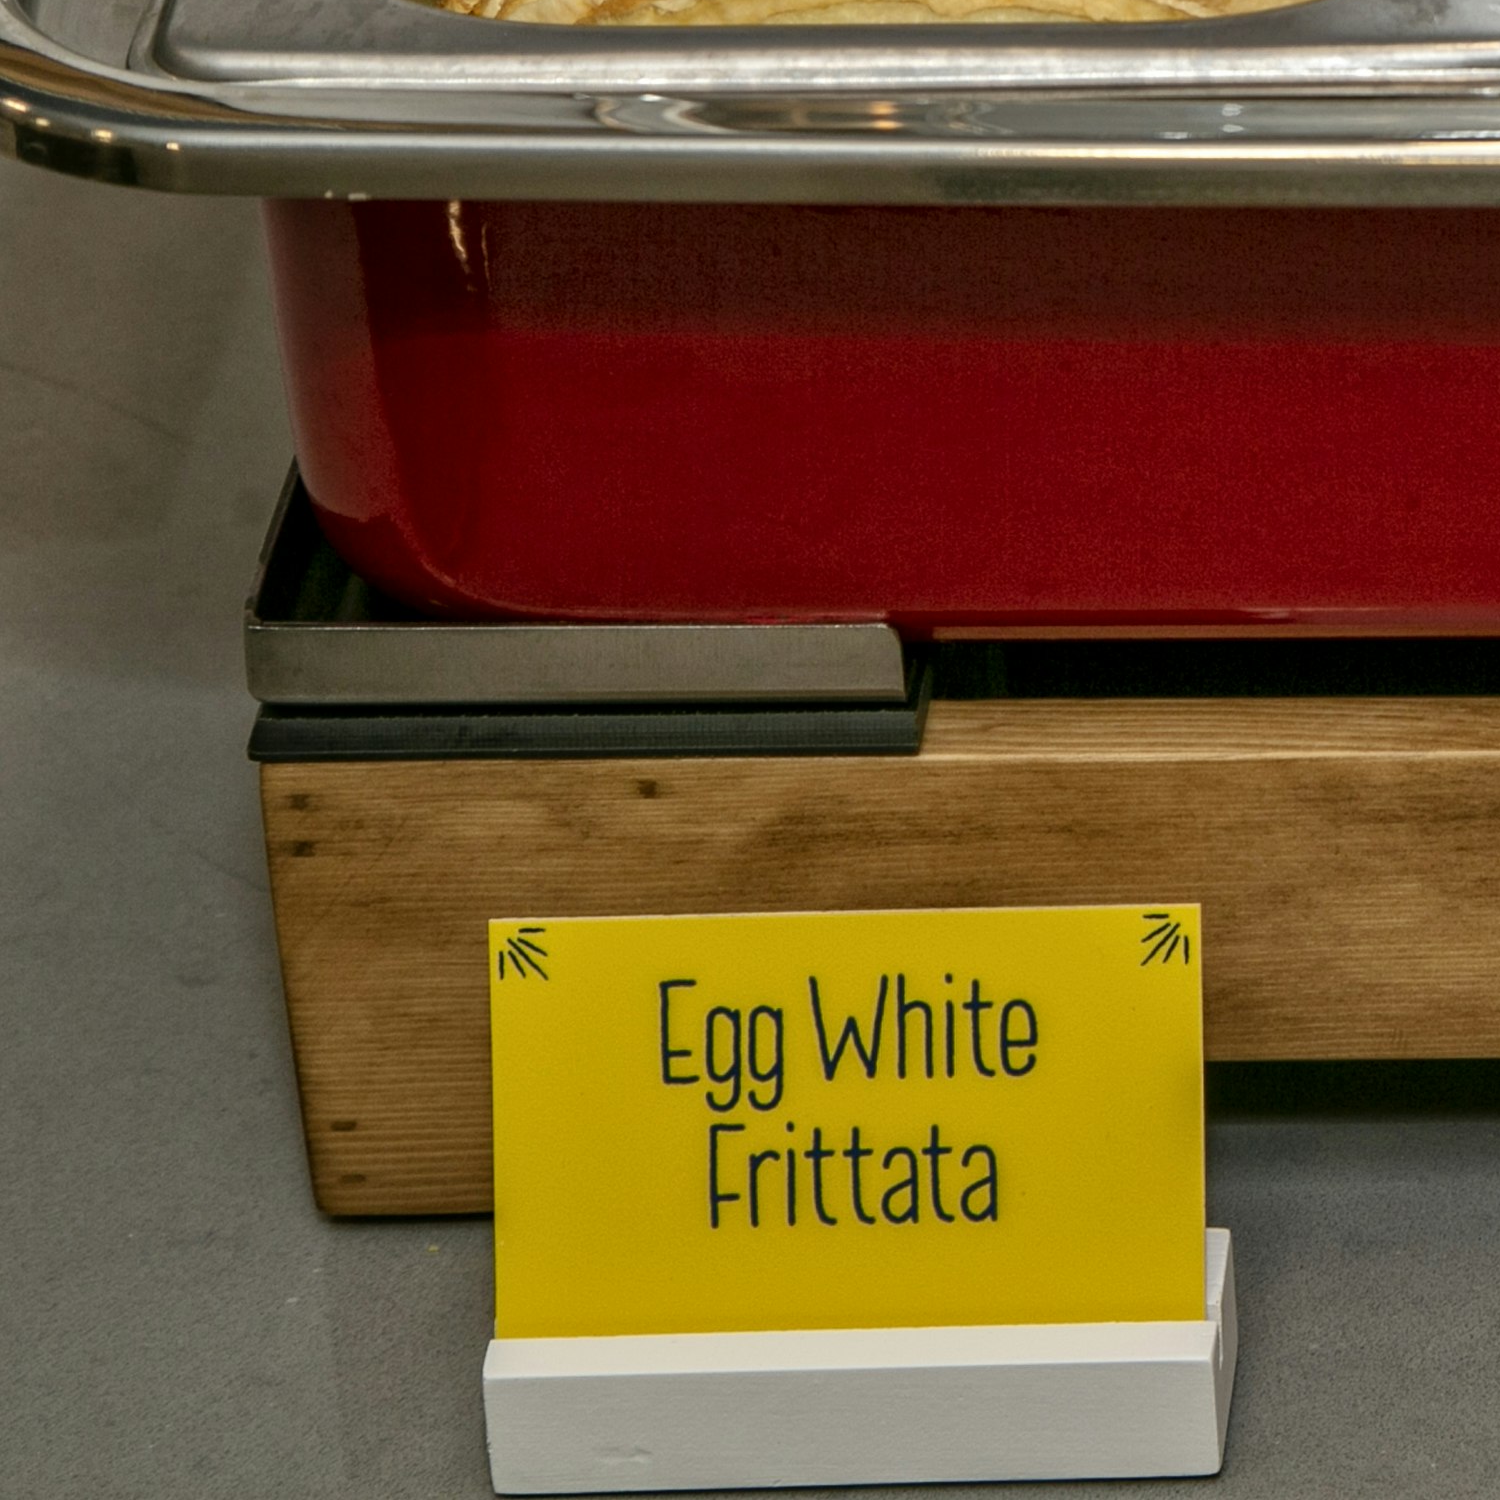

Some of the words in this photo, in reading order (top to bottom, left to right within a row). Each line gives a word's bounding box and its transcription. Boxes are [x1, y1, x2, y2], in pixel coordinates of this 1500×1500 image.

[658, 979, 785, 1112] Egg
[809, 973, 1039, 1082] White
[708, 1122, 1000, 1230] Frittata
